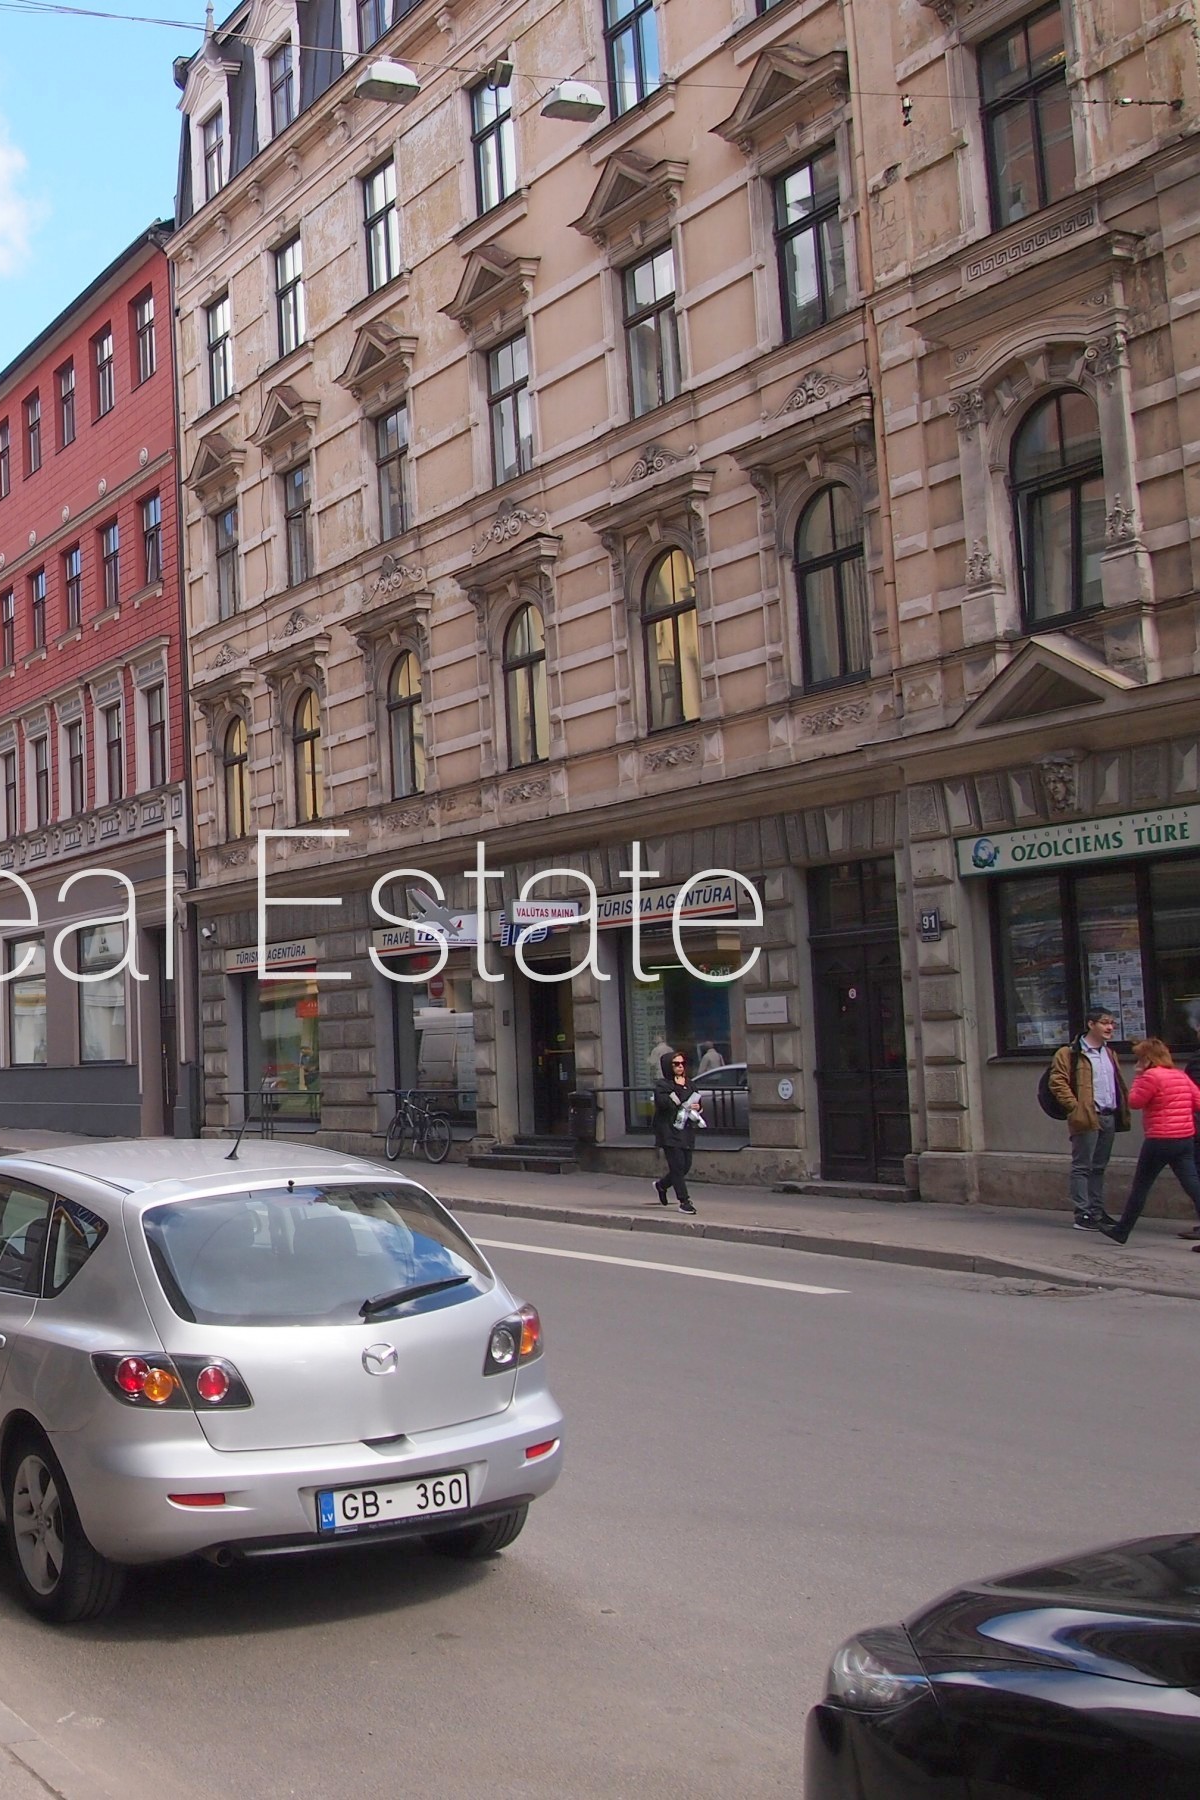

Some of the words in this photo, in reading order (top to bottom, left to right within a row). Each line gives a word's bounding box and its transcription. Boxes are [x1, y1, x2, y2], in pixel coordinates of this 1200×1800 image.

[1010, 831, 1124, 862] OZOLCIEMS
[1133, 822, 1190, 846] TŪRE
[656, 885, 732, 912] AĢNTŪRA
[550, 908, 575, 919] MAINA
[922, 915, 936, 929] 91
[382, 930, 409, 946] TRAVE
[236, 950, 265, 964] TŪRISM
[322, 1513, 334, 1523] LV
